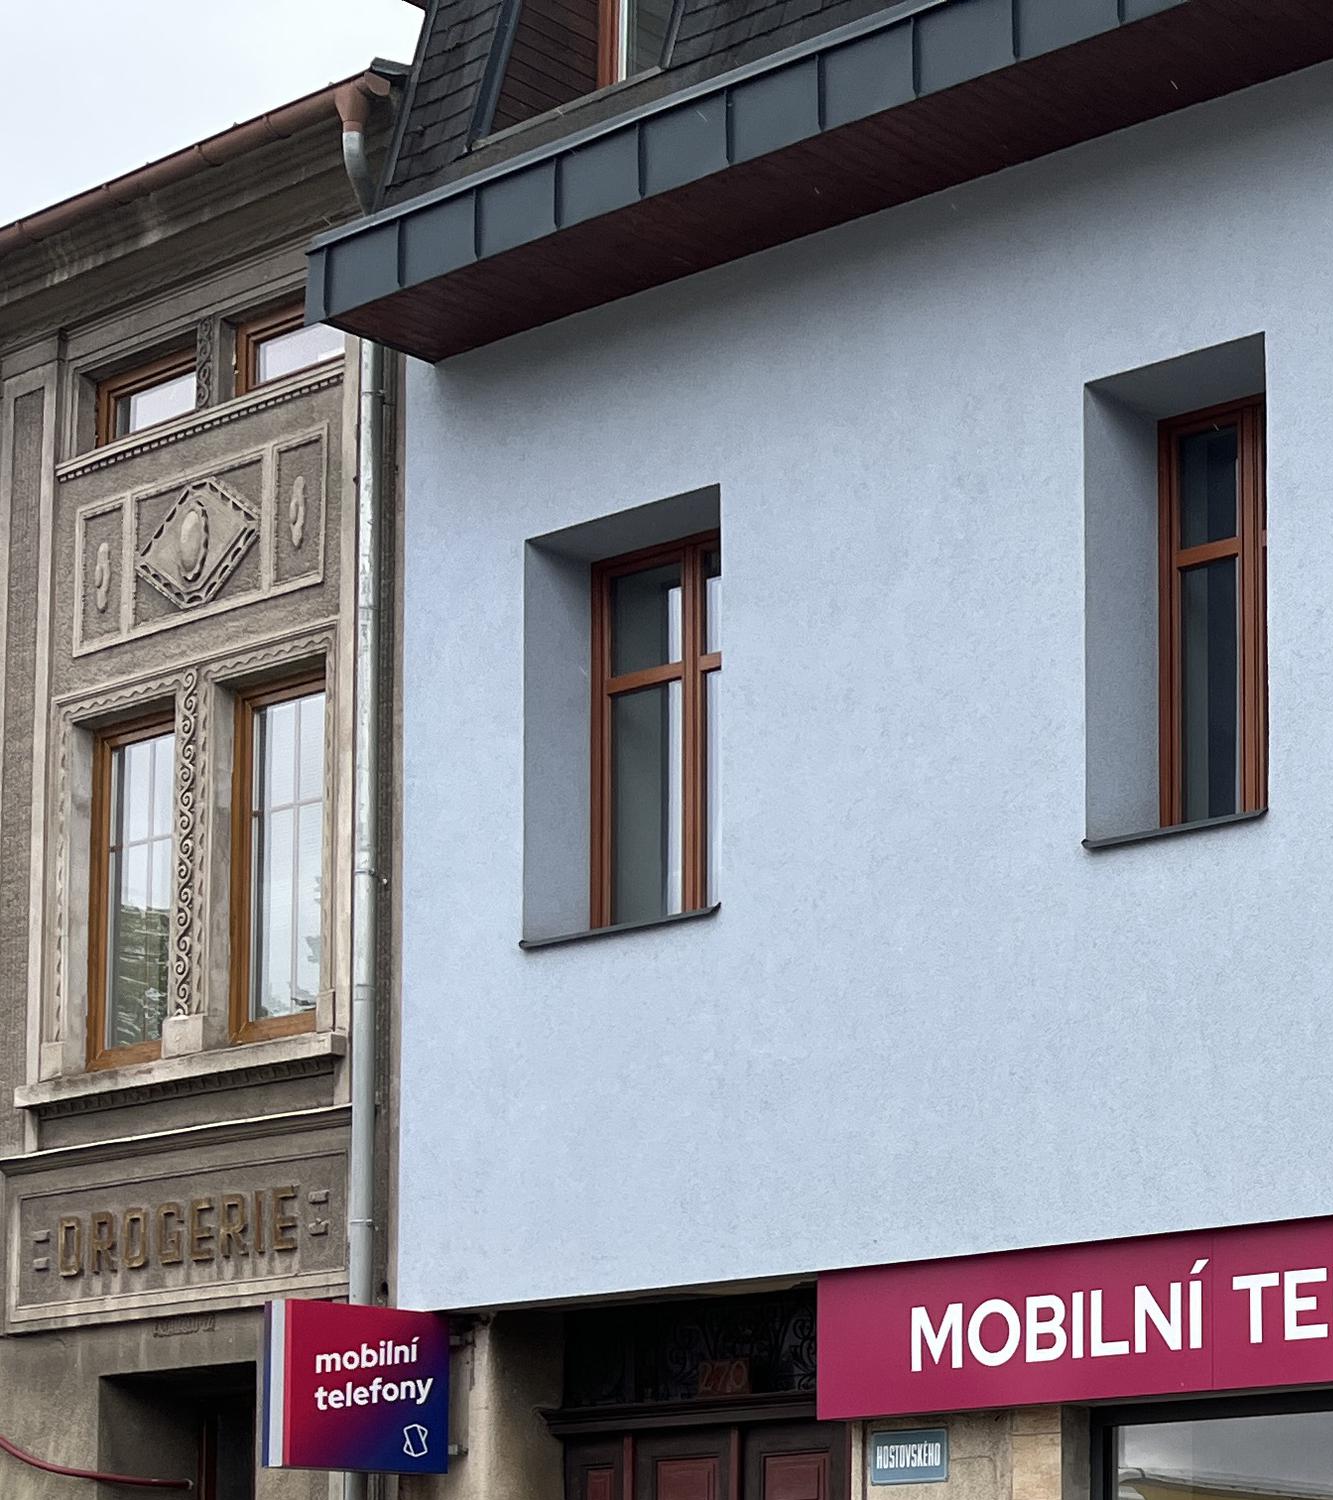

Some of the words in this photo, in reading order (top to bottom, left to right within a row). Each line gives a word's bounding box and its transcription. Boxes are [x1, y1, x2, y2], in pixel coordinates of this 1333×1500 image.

[57, 1184, 300, 1278] DROGERIE
[911, 1259, 1210, 1373] MOBILNÍ
[315, 1336, 420, 1374] mobilní
[314, 1377, 434, 1411] telefony
[876, 1441, 942, 1469] HOSTOVSKÉHO
